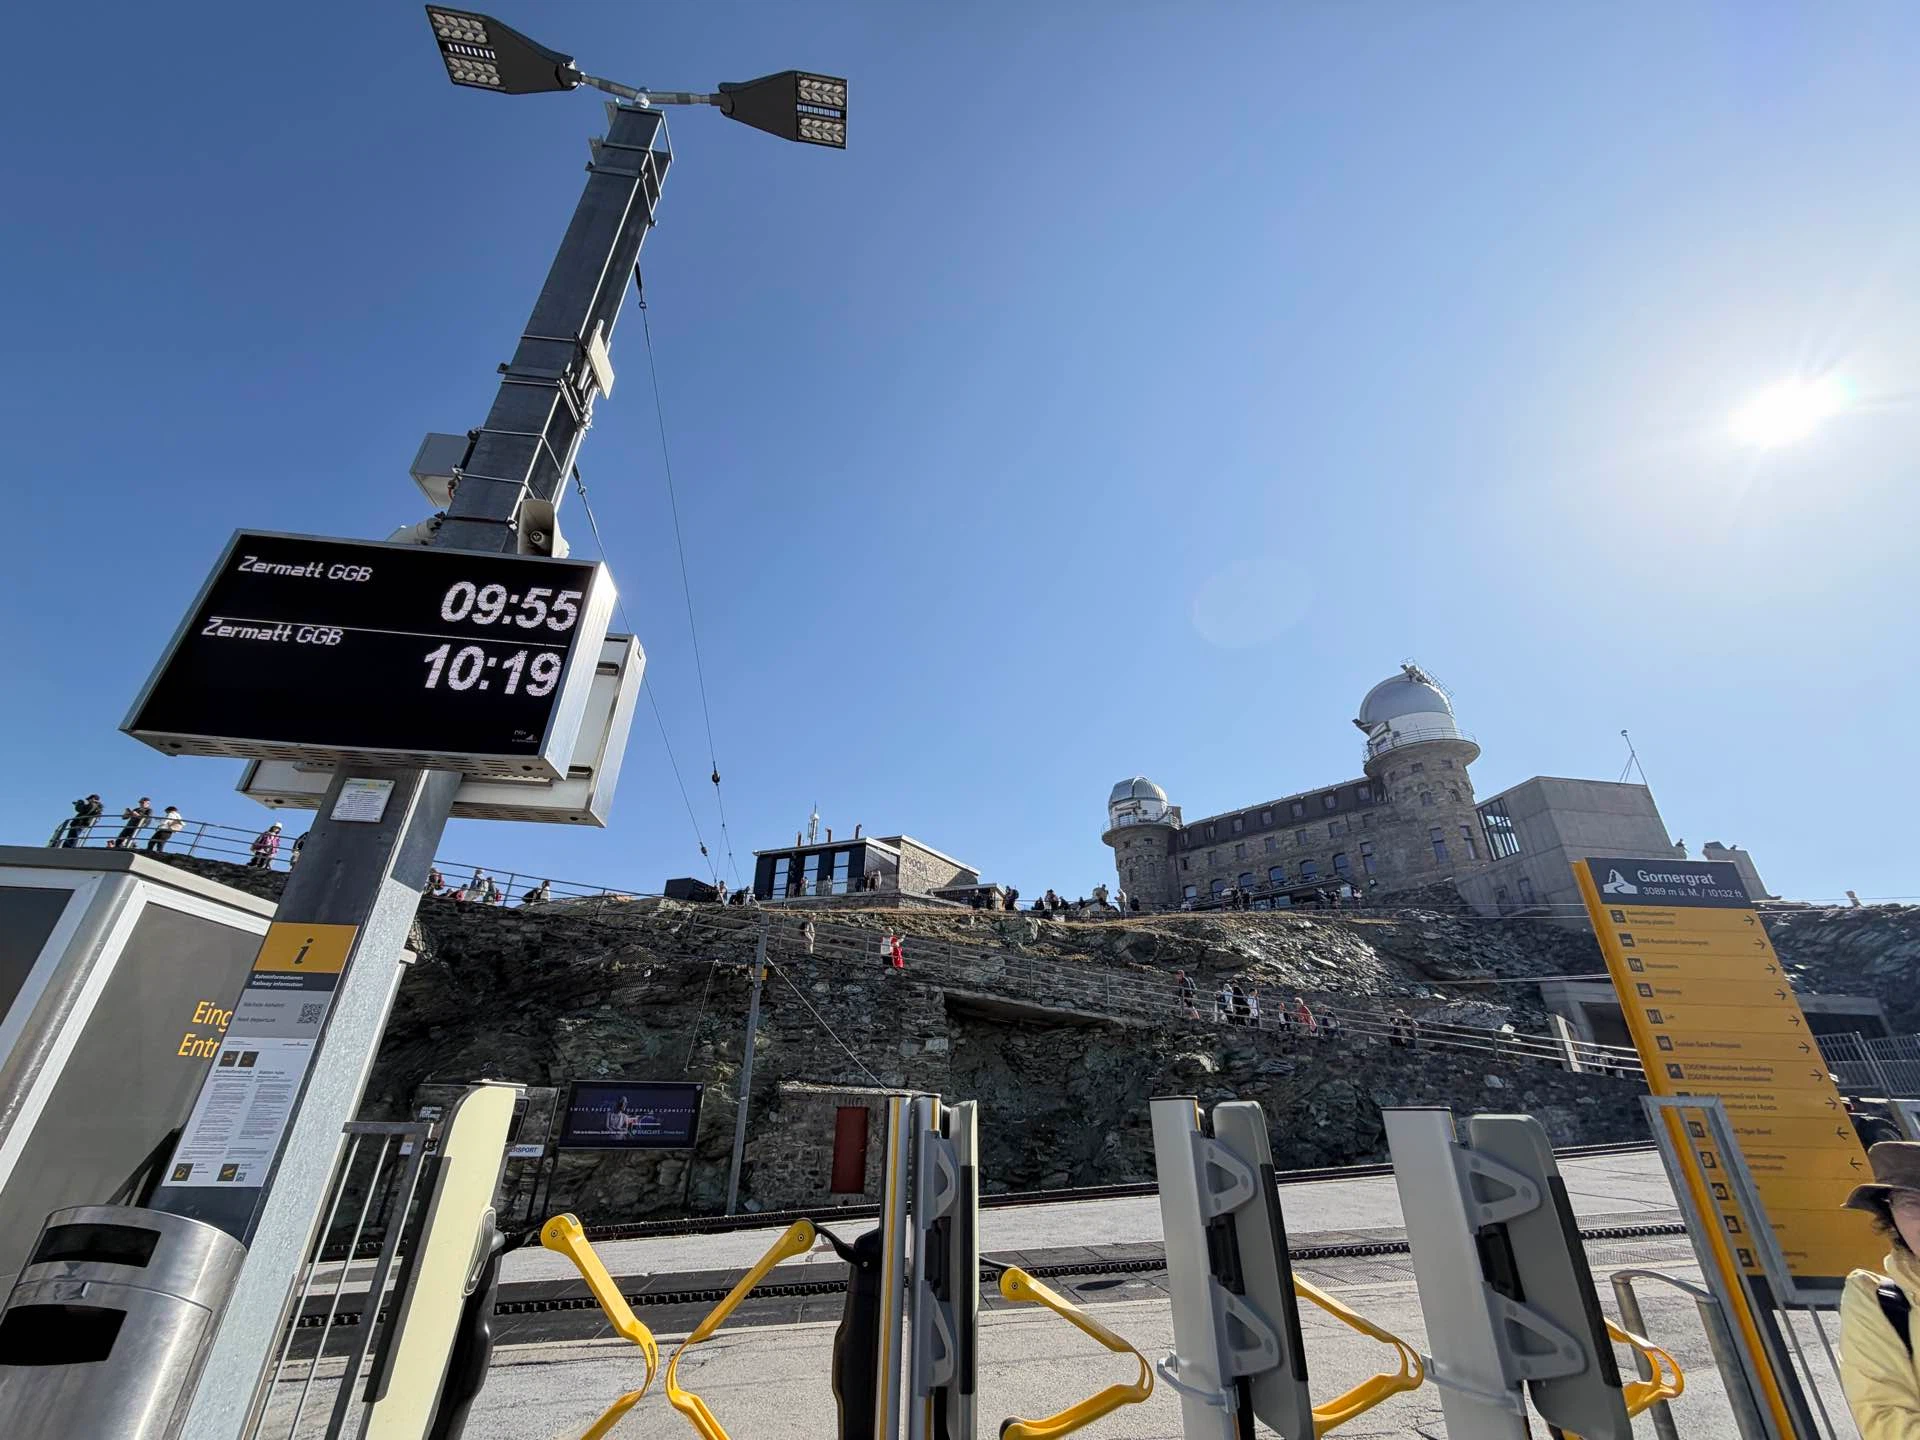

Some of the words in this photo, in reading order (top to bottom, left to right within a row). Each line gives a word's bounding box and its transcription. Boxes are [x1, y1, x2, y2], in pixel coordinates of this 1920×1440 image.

[238, 555, 324, 578] Zermatt
[327, 564, 373, 582] GGB
[441, 581, 583, 631] 09:55
[201, 617, 292, 642] Zermatt
[296, 625, 344, 646] GGB
[424, 643, 562, 697] 10:19
[1637, 869, 1716, 886] Gornergrat
[1643, 886, 1666, 896] 3089
[178, 1033, 220, 1058] Entr
